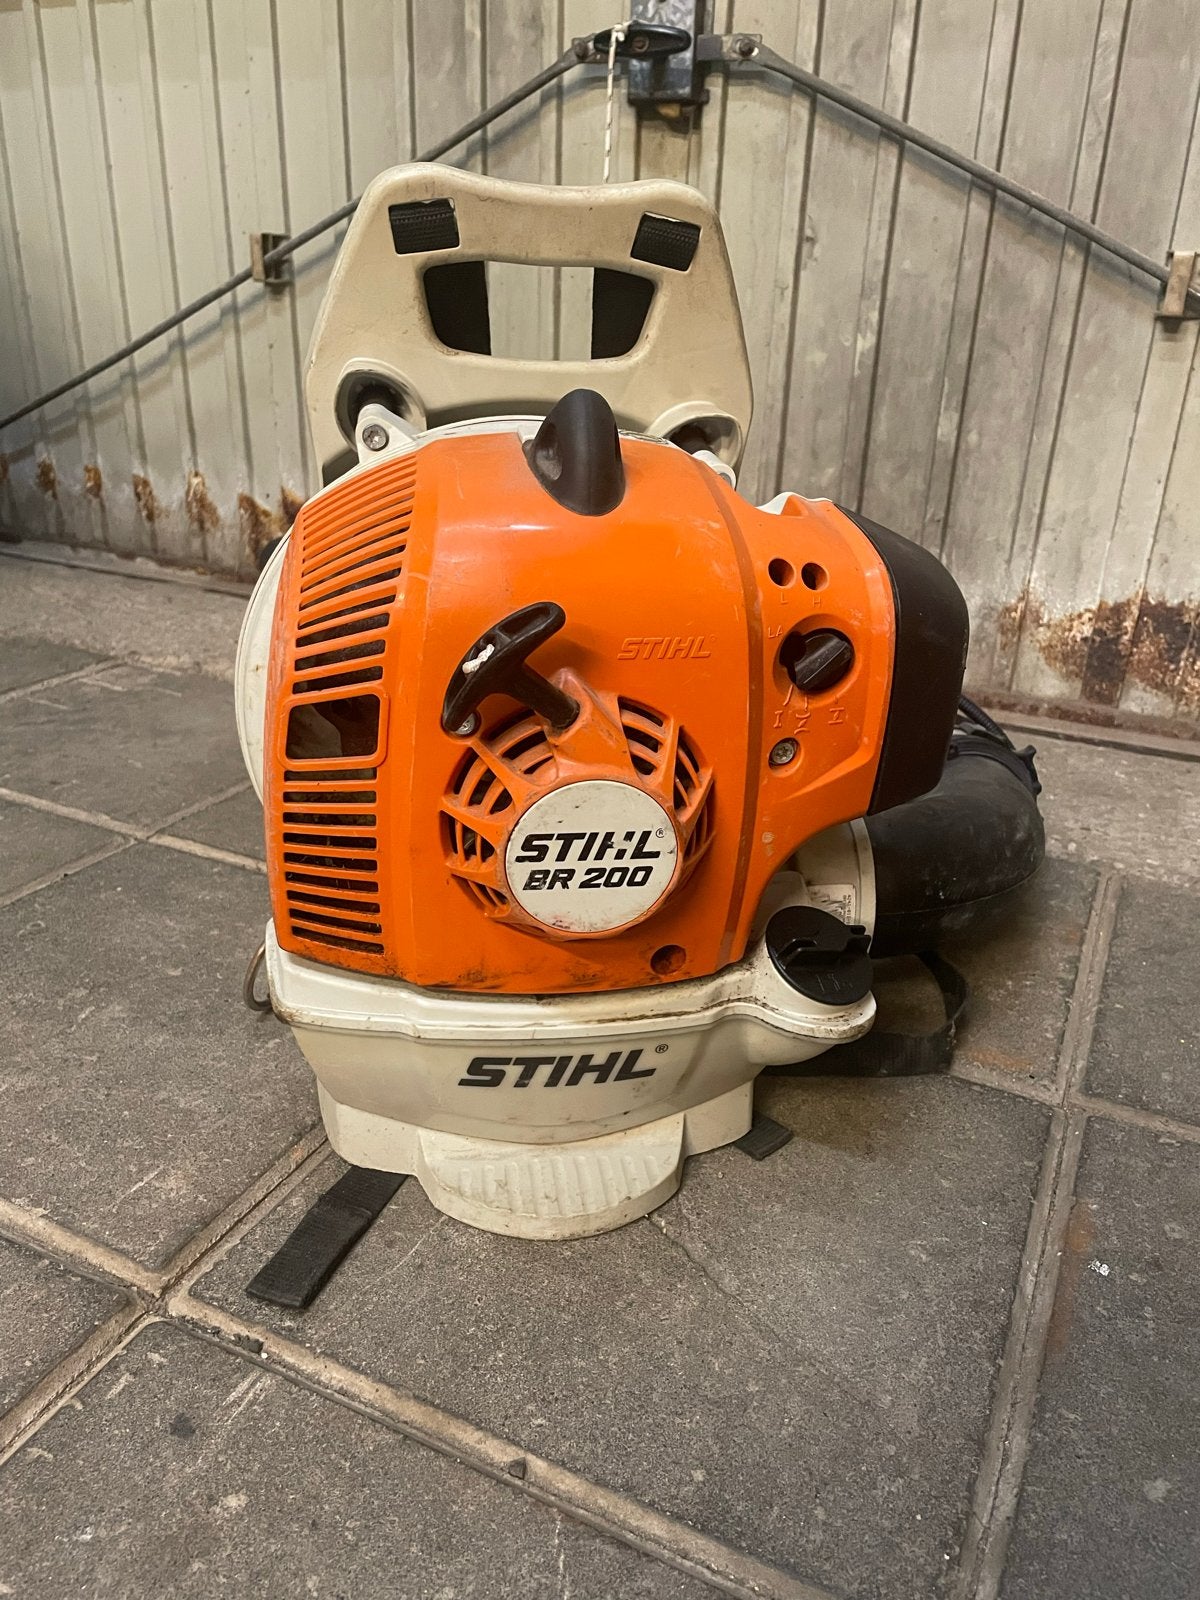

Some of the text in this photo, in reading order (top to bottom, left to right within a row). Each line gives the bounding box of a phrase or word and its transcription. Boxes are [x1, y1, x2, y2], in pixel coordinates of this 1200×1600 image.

[617, 636, 712, 660] STIHL
[522, 865, 654, 891] BR 200
[457, 1048, 657, 1088] STIHL
